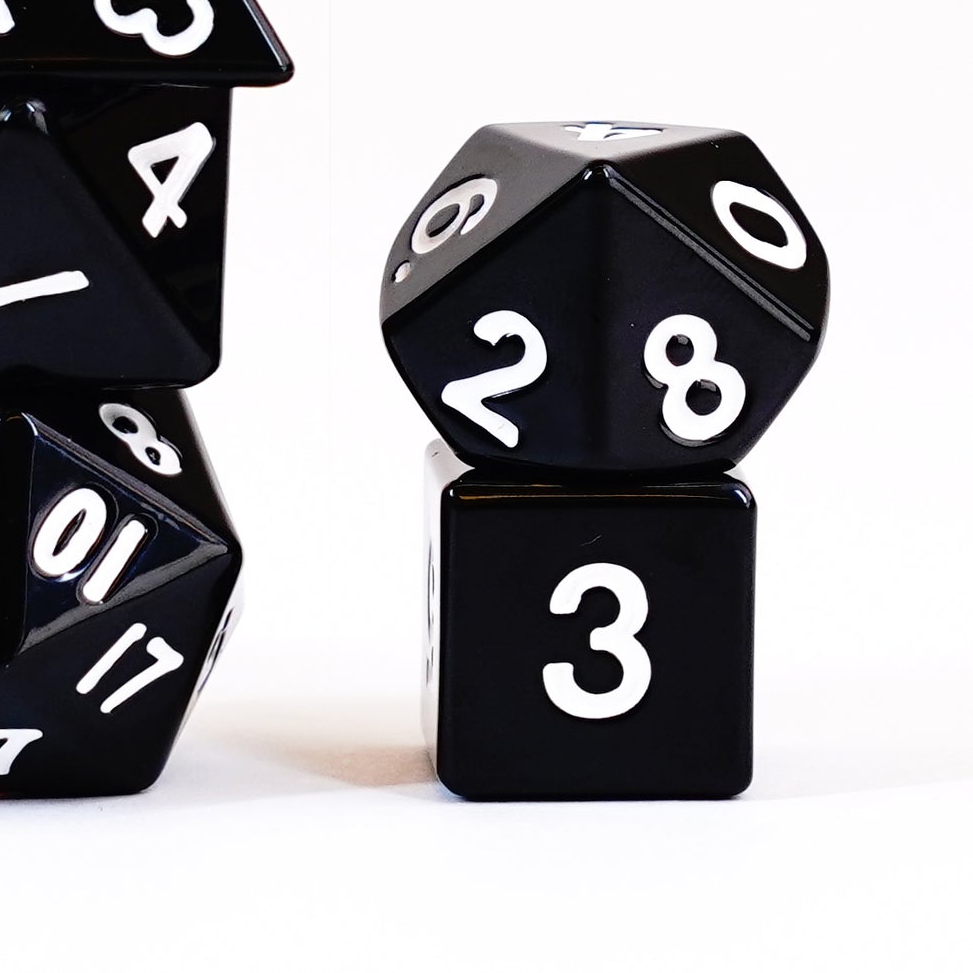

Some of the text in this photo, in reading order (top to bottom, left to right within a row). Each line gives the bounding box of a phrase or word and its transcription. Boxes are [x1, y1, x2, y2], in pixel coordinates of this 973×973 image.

[128, 122, 214, 237] 4
[712, 181, 806, 269] 0
[442, 311, 547, 447] 2
[644, 314, 745, 440] 8
[100, 404, 182, 475] 8
[34, 488, 147, 604] 10
[76, 623, 183, 713] 17
[543, 563, 651, 718] 3
